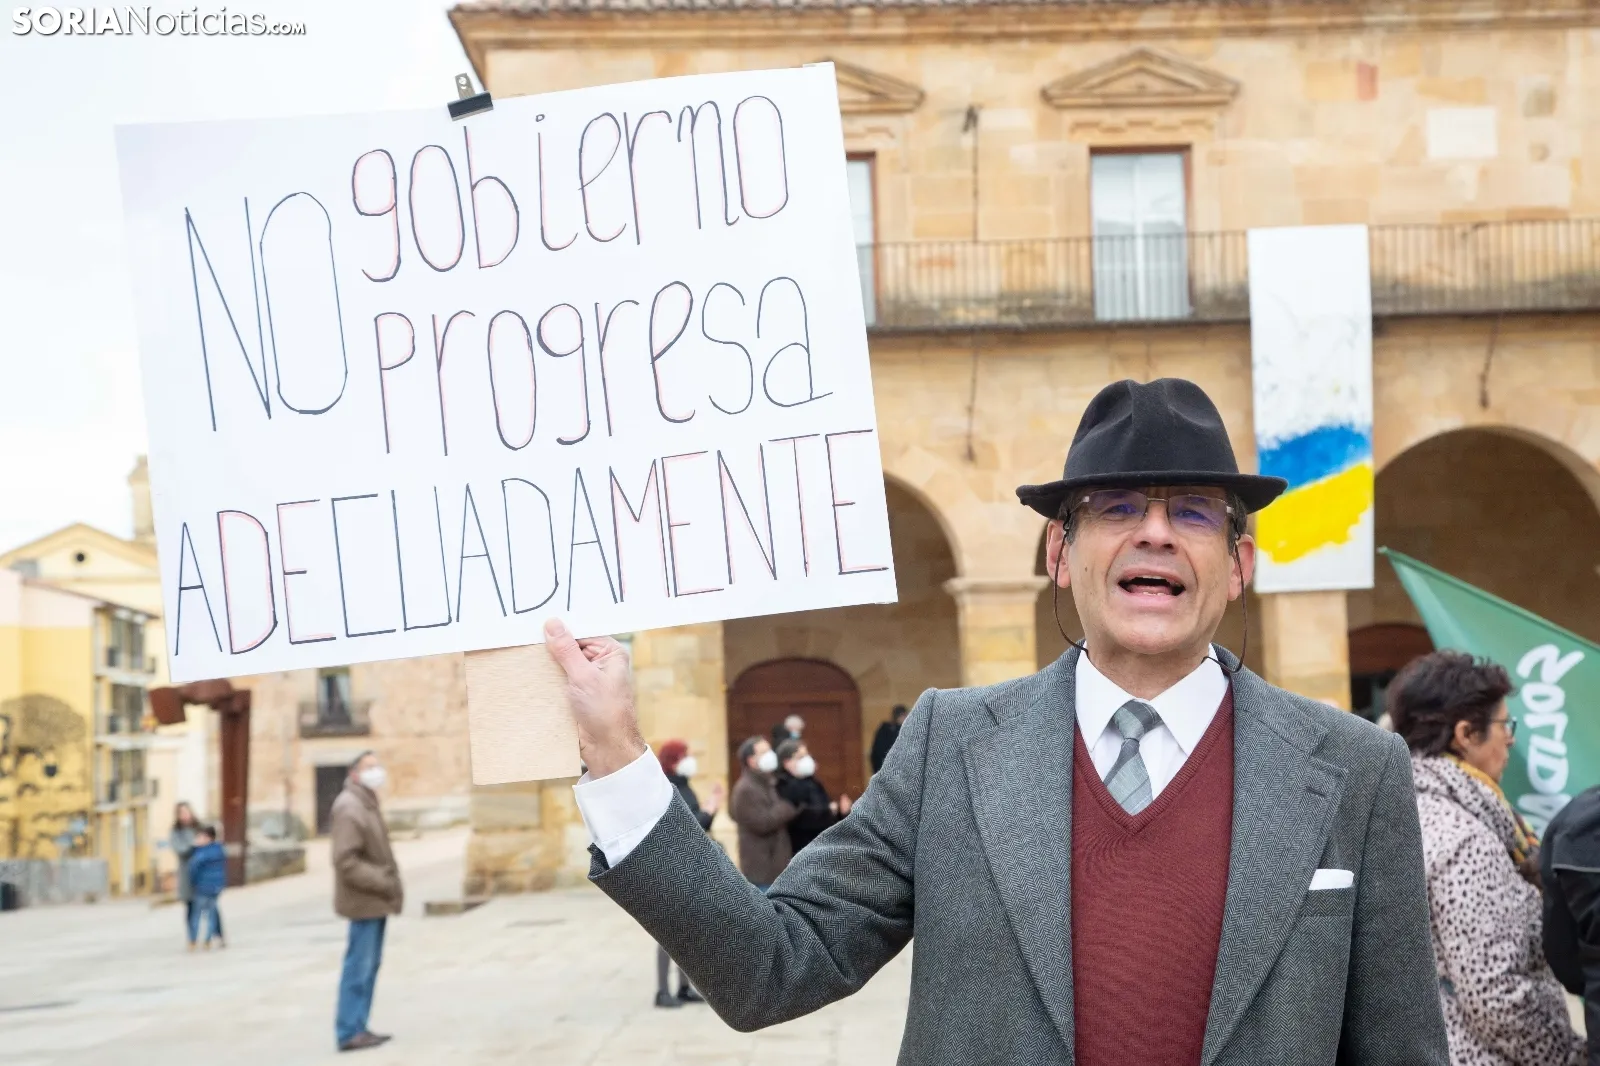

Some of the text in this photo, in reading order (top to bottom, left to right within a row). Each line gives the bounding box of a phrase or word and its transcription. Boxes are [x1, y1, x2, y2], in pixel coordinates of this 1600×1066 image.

[185, 95, 789, 432] NO gobierno
[175, 429, 889, 655] ADECUADAMENTE
